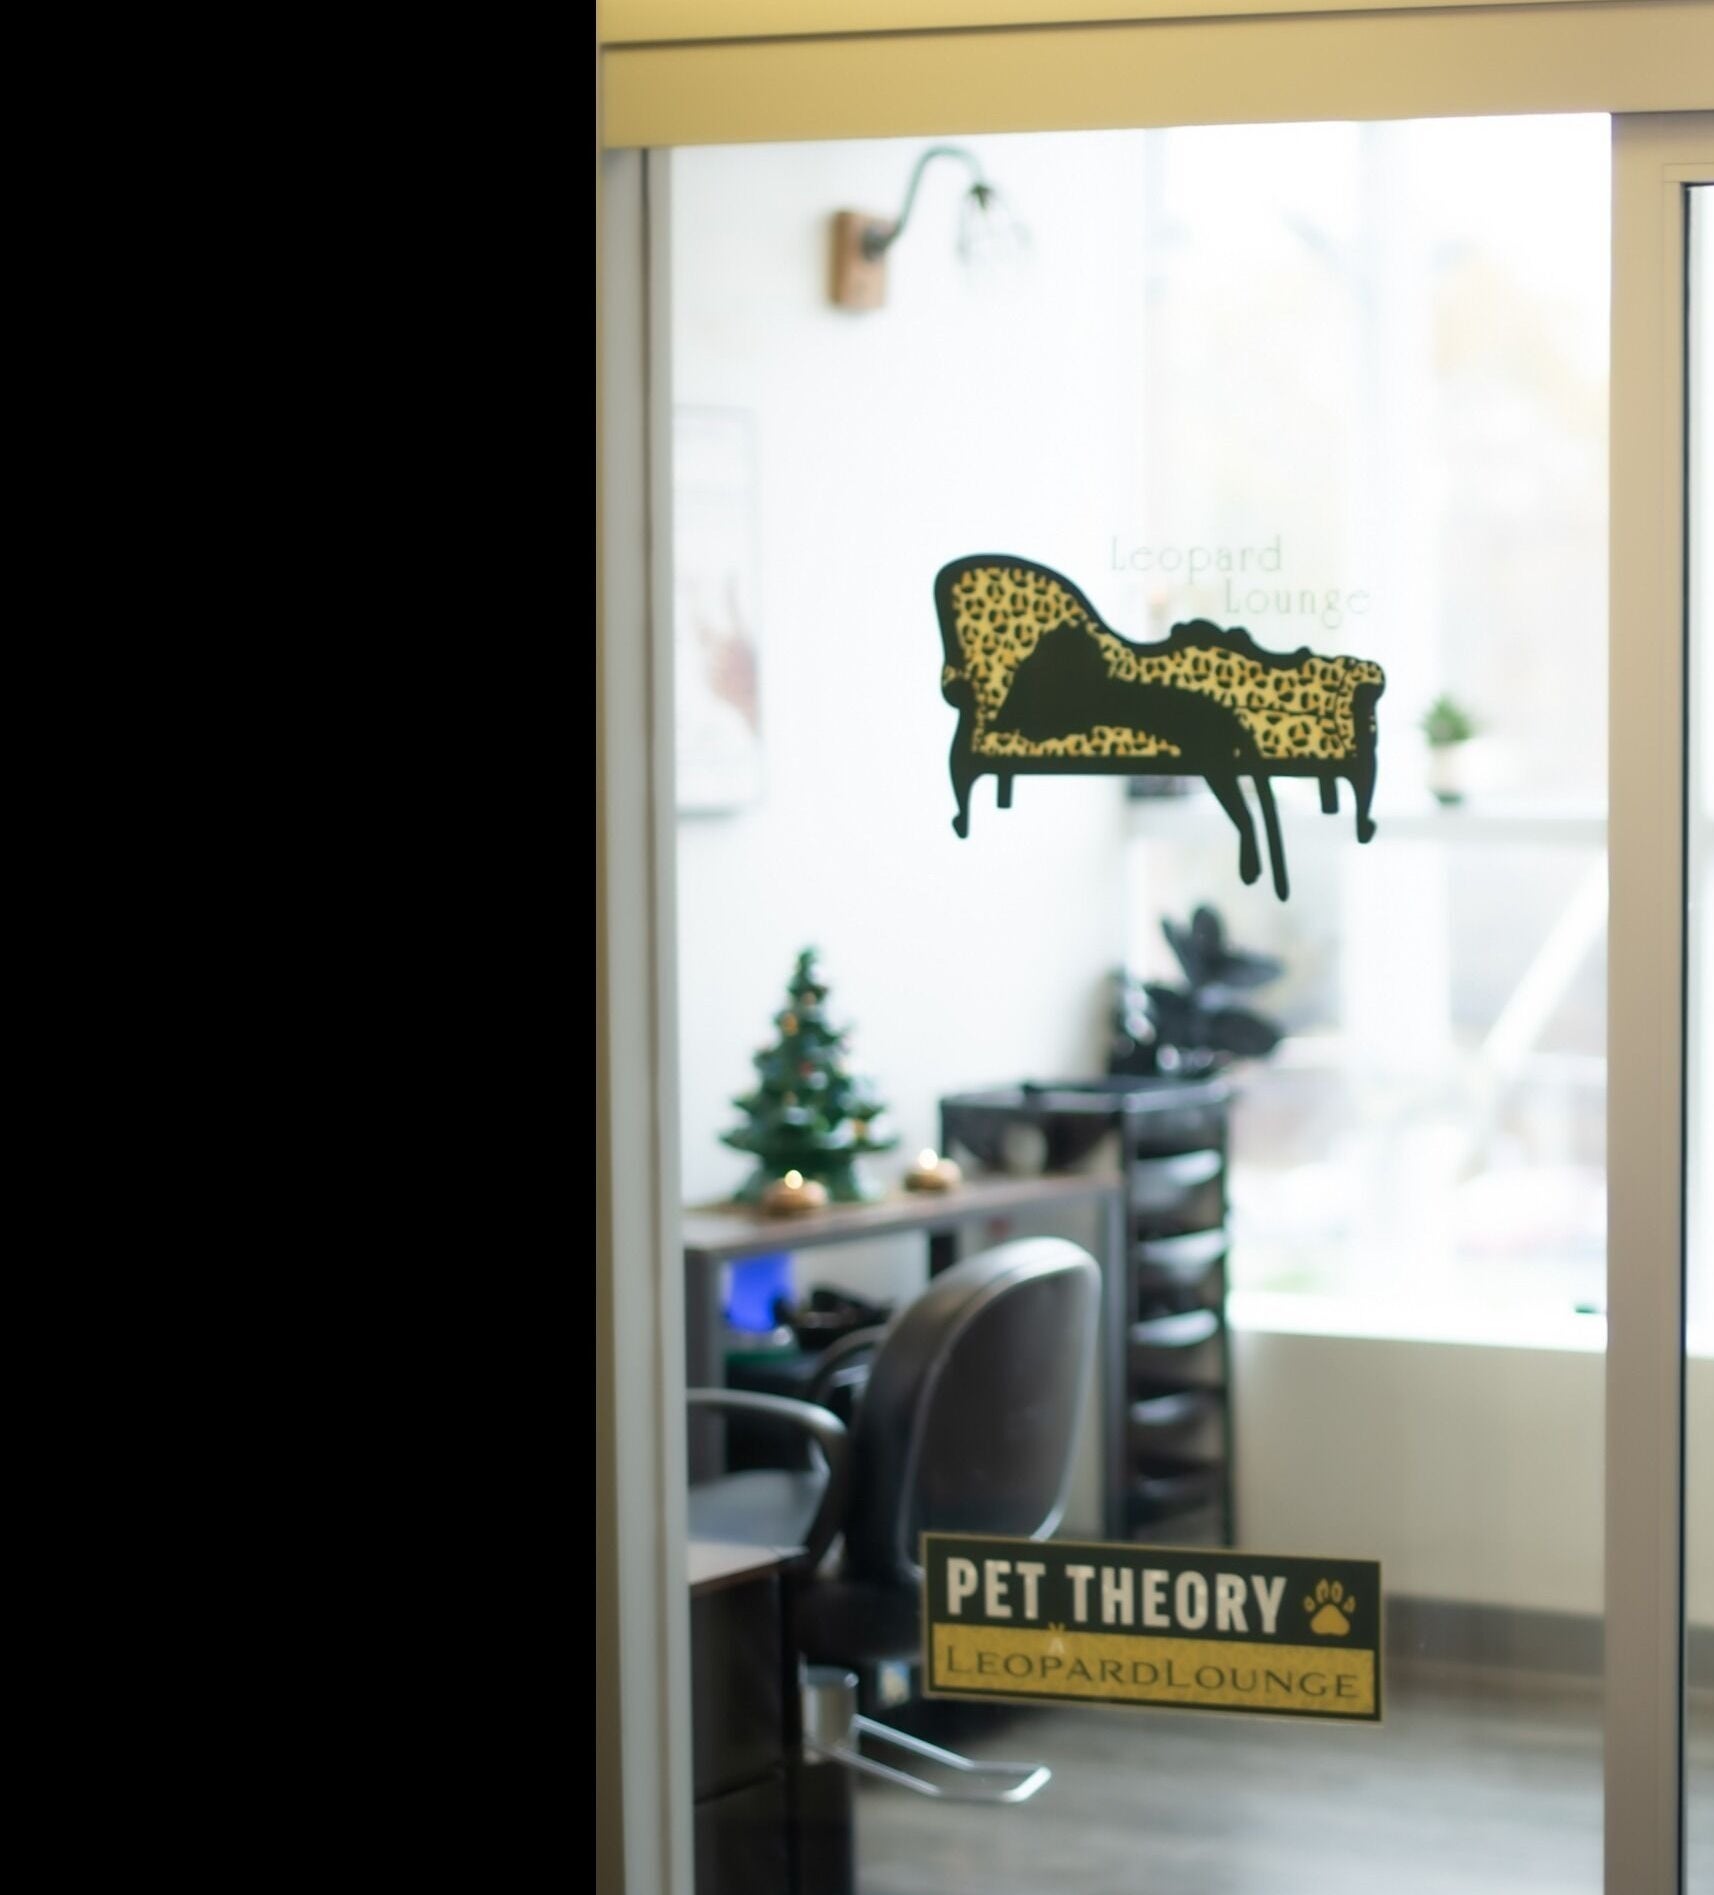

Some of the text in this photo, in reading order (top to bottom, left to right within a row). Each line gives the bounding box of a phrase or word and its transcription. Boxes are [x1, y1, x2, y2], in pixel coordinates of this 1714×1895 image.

[1111, 534, 1283, 585] Leopard
[1225, 578, 1371, 630] Lounge
[946, 1557, 1287, 1633] PET THEORY
